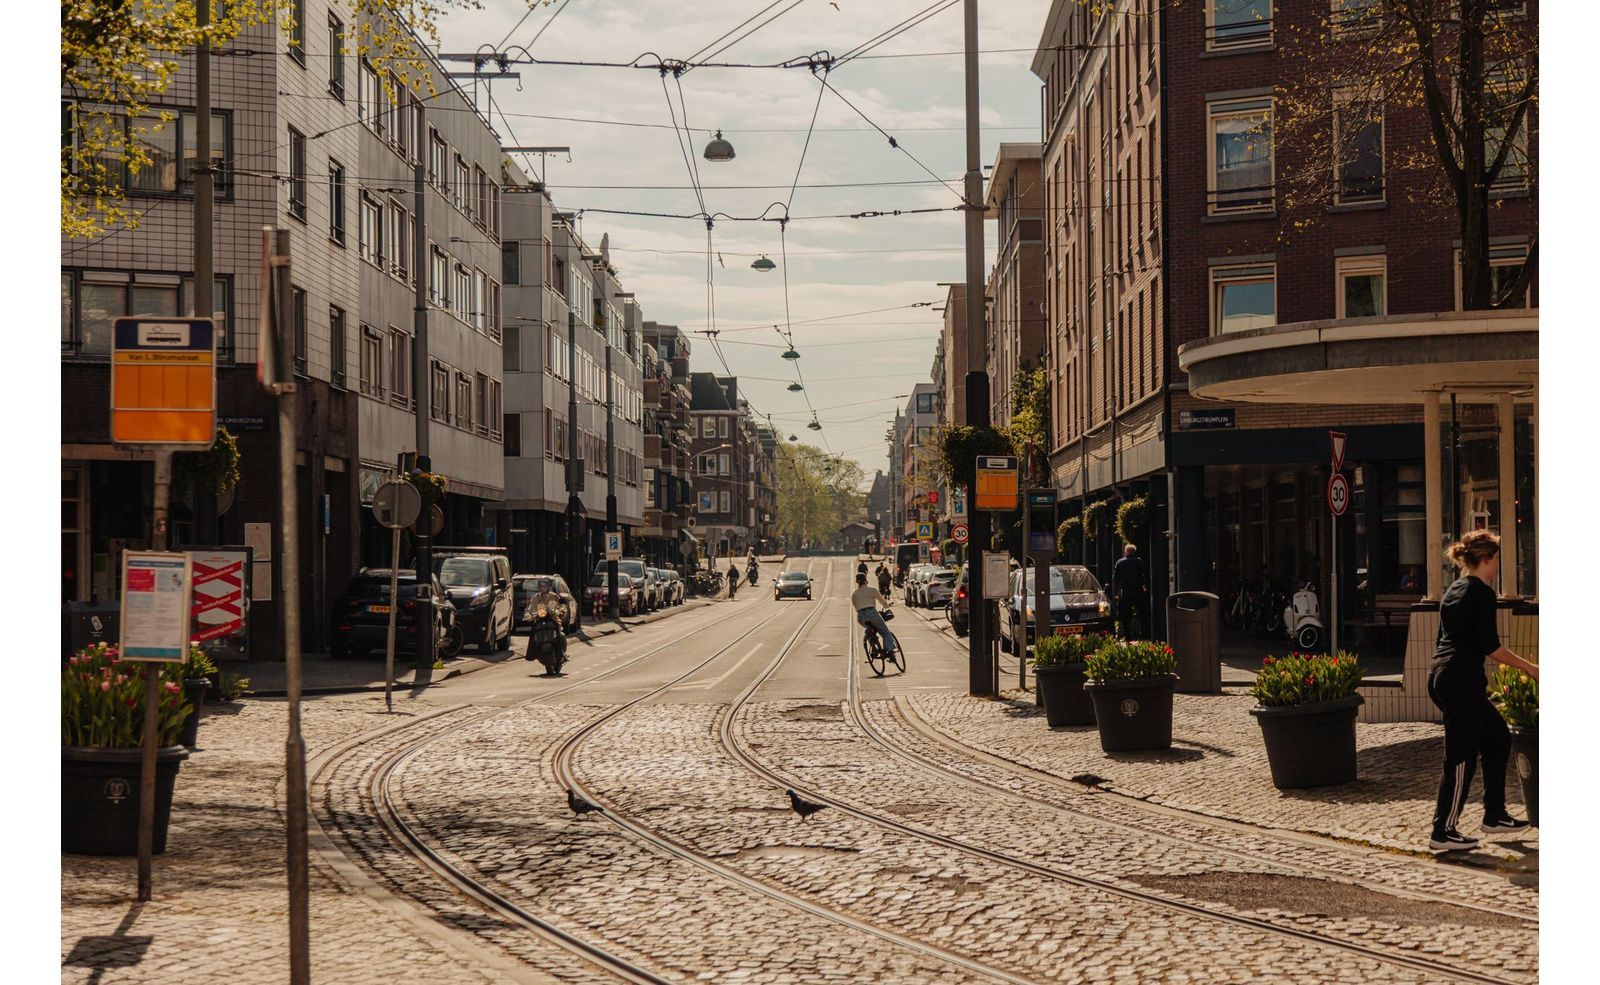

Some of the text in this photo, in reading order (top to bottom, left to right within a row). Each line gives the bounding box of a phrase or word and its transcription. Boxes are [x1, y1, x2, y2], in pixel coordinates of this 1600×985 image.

[128, 353, 143, 361] Van
[1333, 486, 1344, 502] 30
[955, 530, 967, 538] 30
